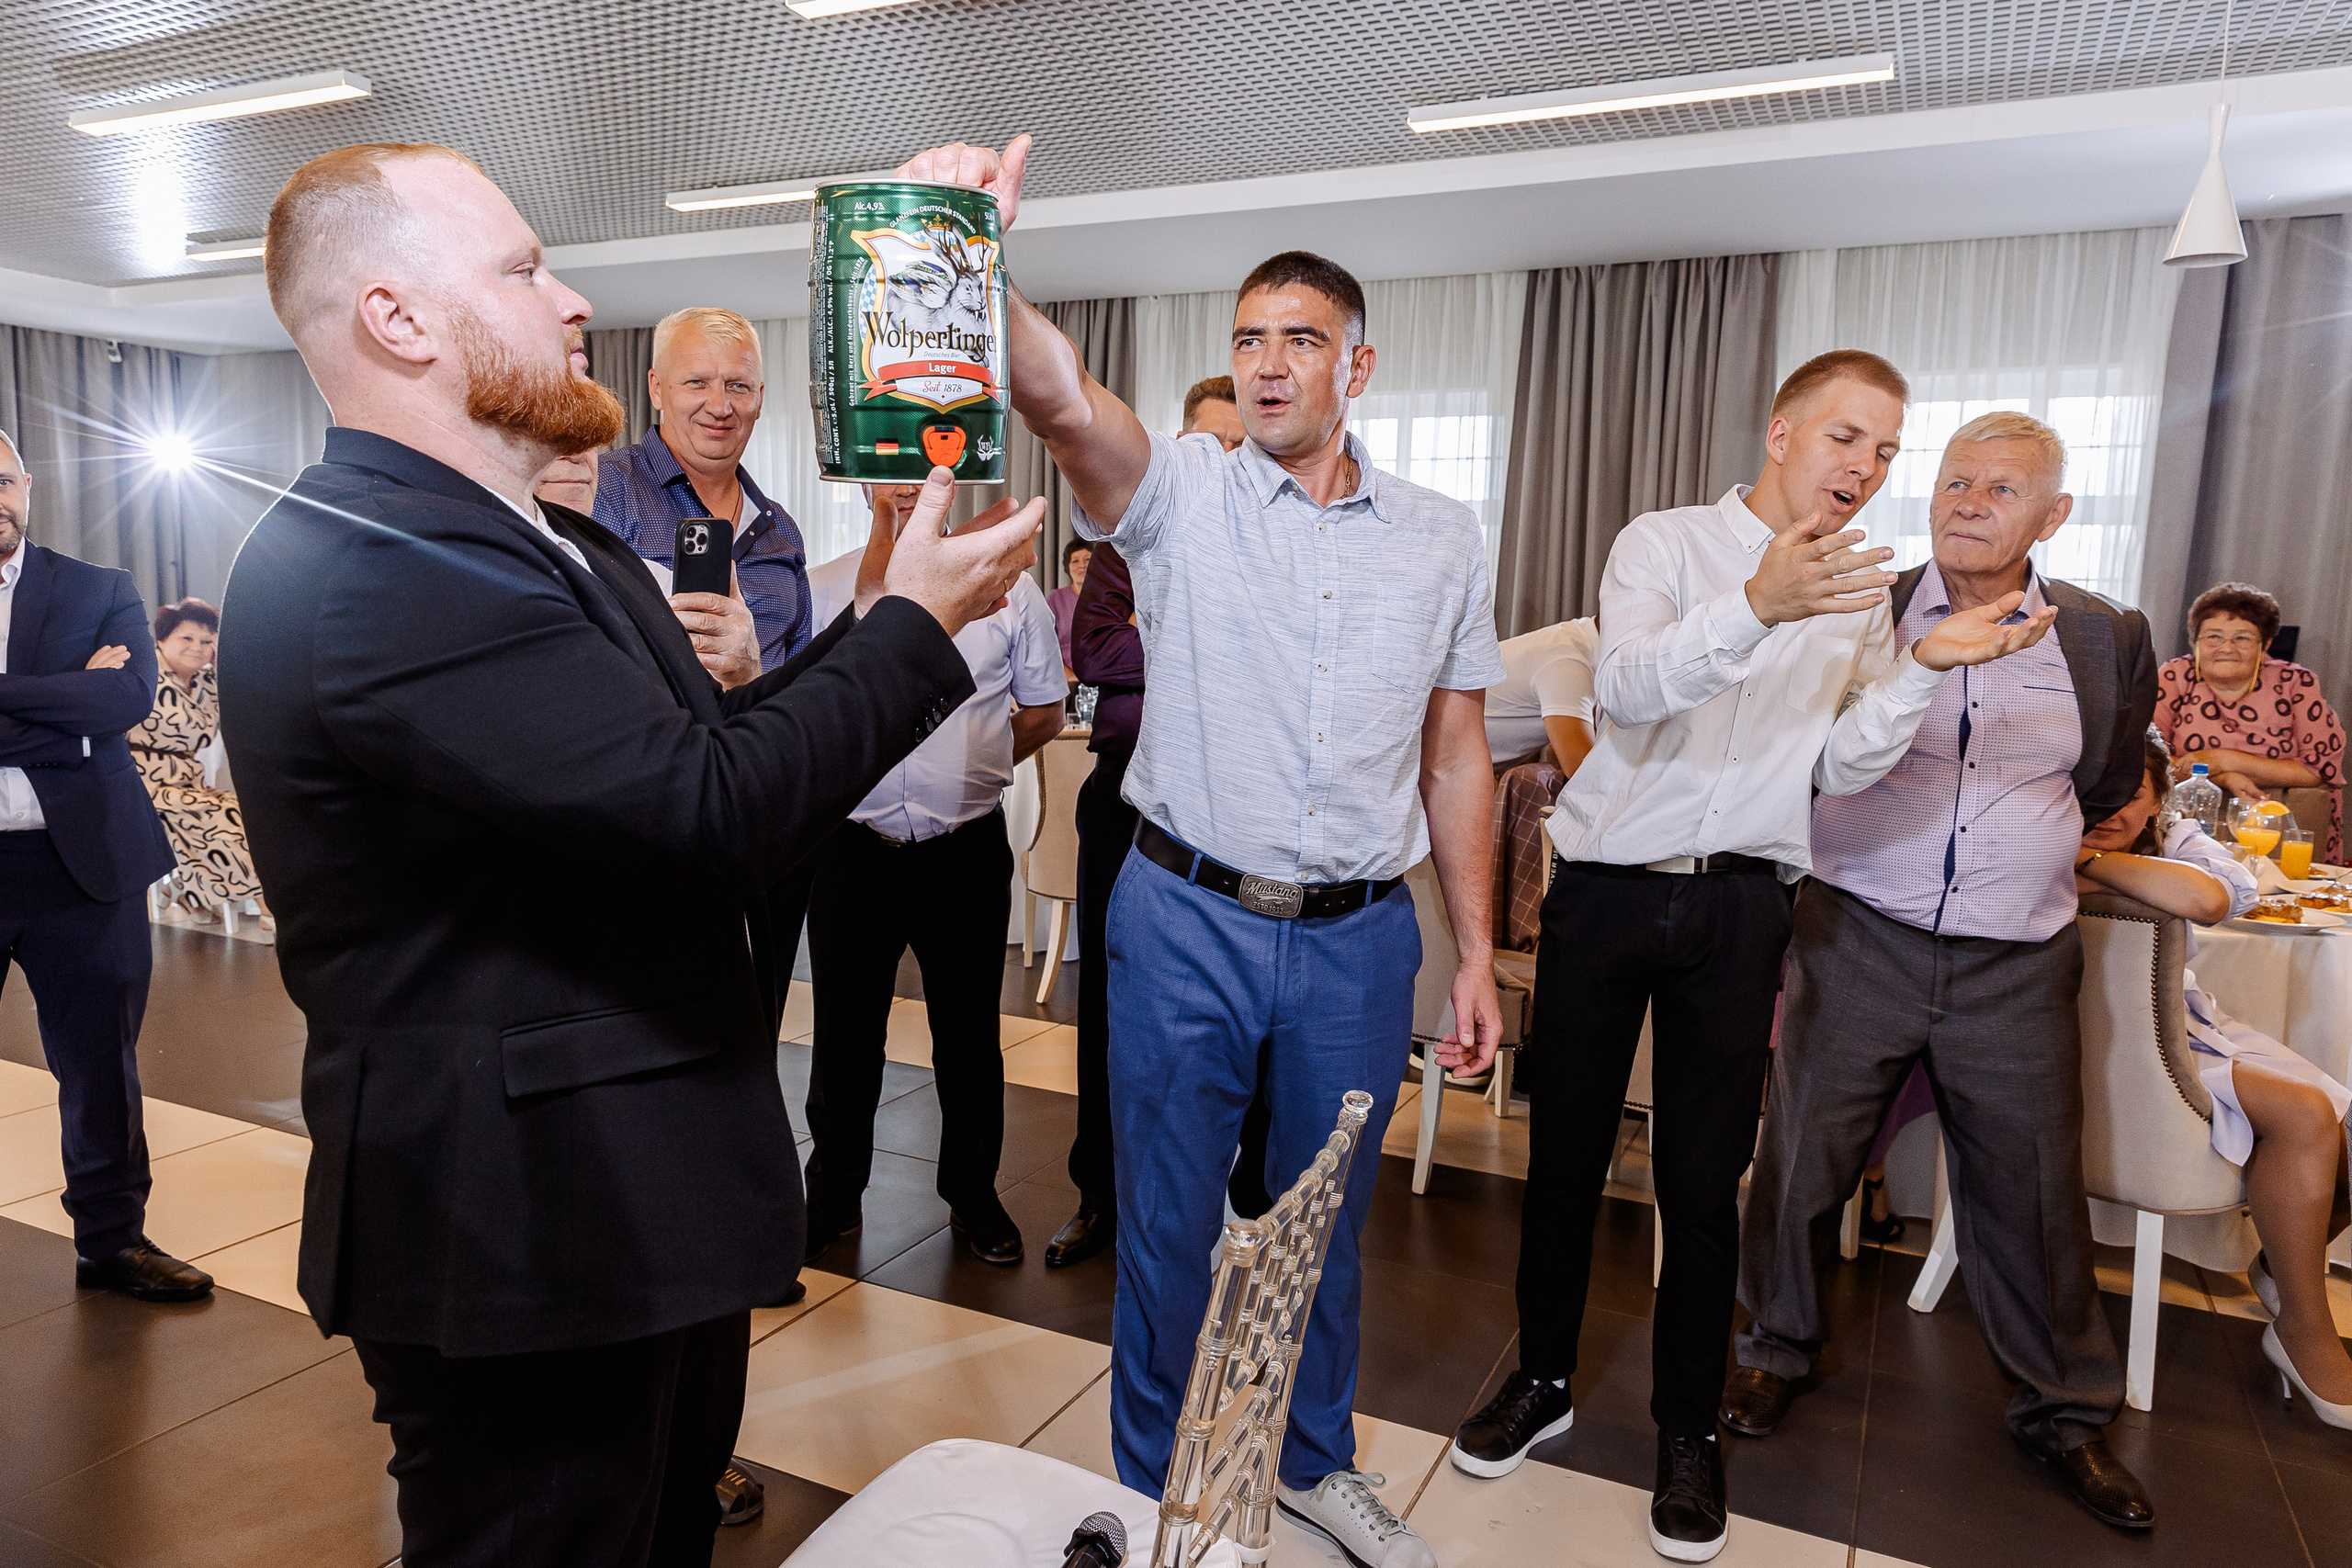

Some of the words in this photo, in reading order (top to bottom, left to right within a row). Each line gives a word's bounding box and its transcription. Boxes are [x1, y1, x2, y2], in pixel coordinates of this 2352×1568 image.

[889, 207, 920, 228] GLANZFEIN
[919, 205, 953, 216] DEUTSCHER
[952, 210, 977, 234] STANDARD
[928, 362, 957, 375] Lager
[922, 380, 942, 393] Seit
[943, 383, 963, 393] 1878
[1245, 882, 1298, 902] Mustang
